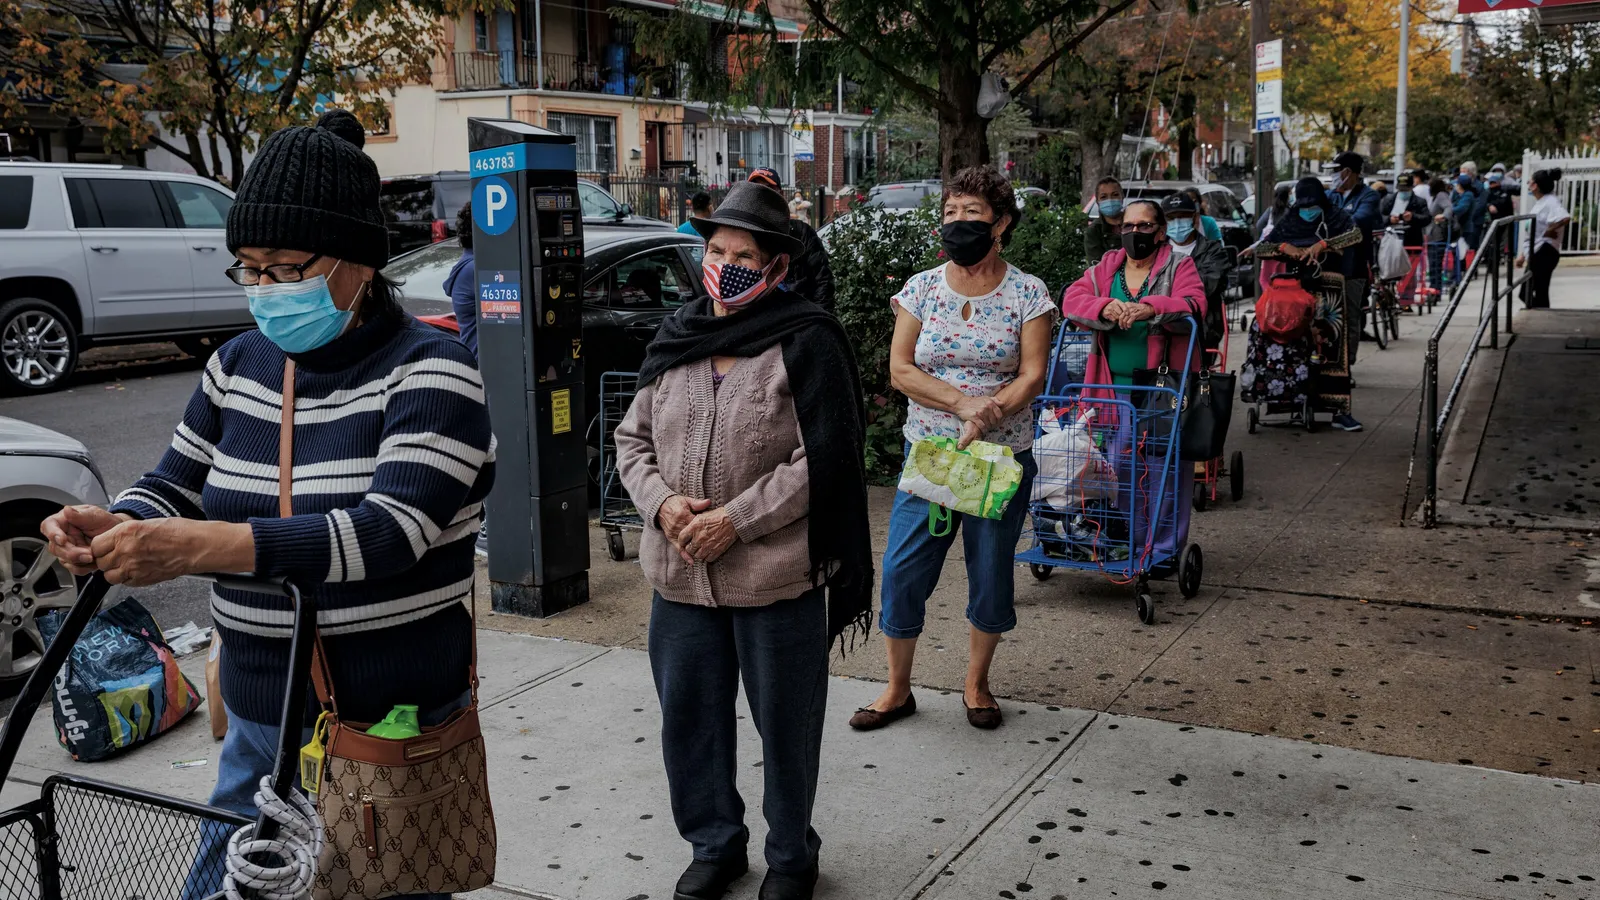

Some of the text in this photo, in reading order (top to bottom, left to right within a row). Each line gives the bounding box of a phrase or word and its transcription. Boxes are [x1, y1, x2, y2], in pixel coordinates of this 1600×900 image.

[475, 156, 514, 170] 463783
[486, 184, 508, 227] P
[481, 289, 518, 300] 463783
[71, 634, 139, 664] YORK
[73, 625, 123, 652] NEW
